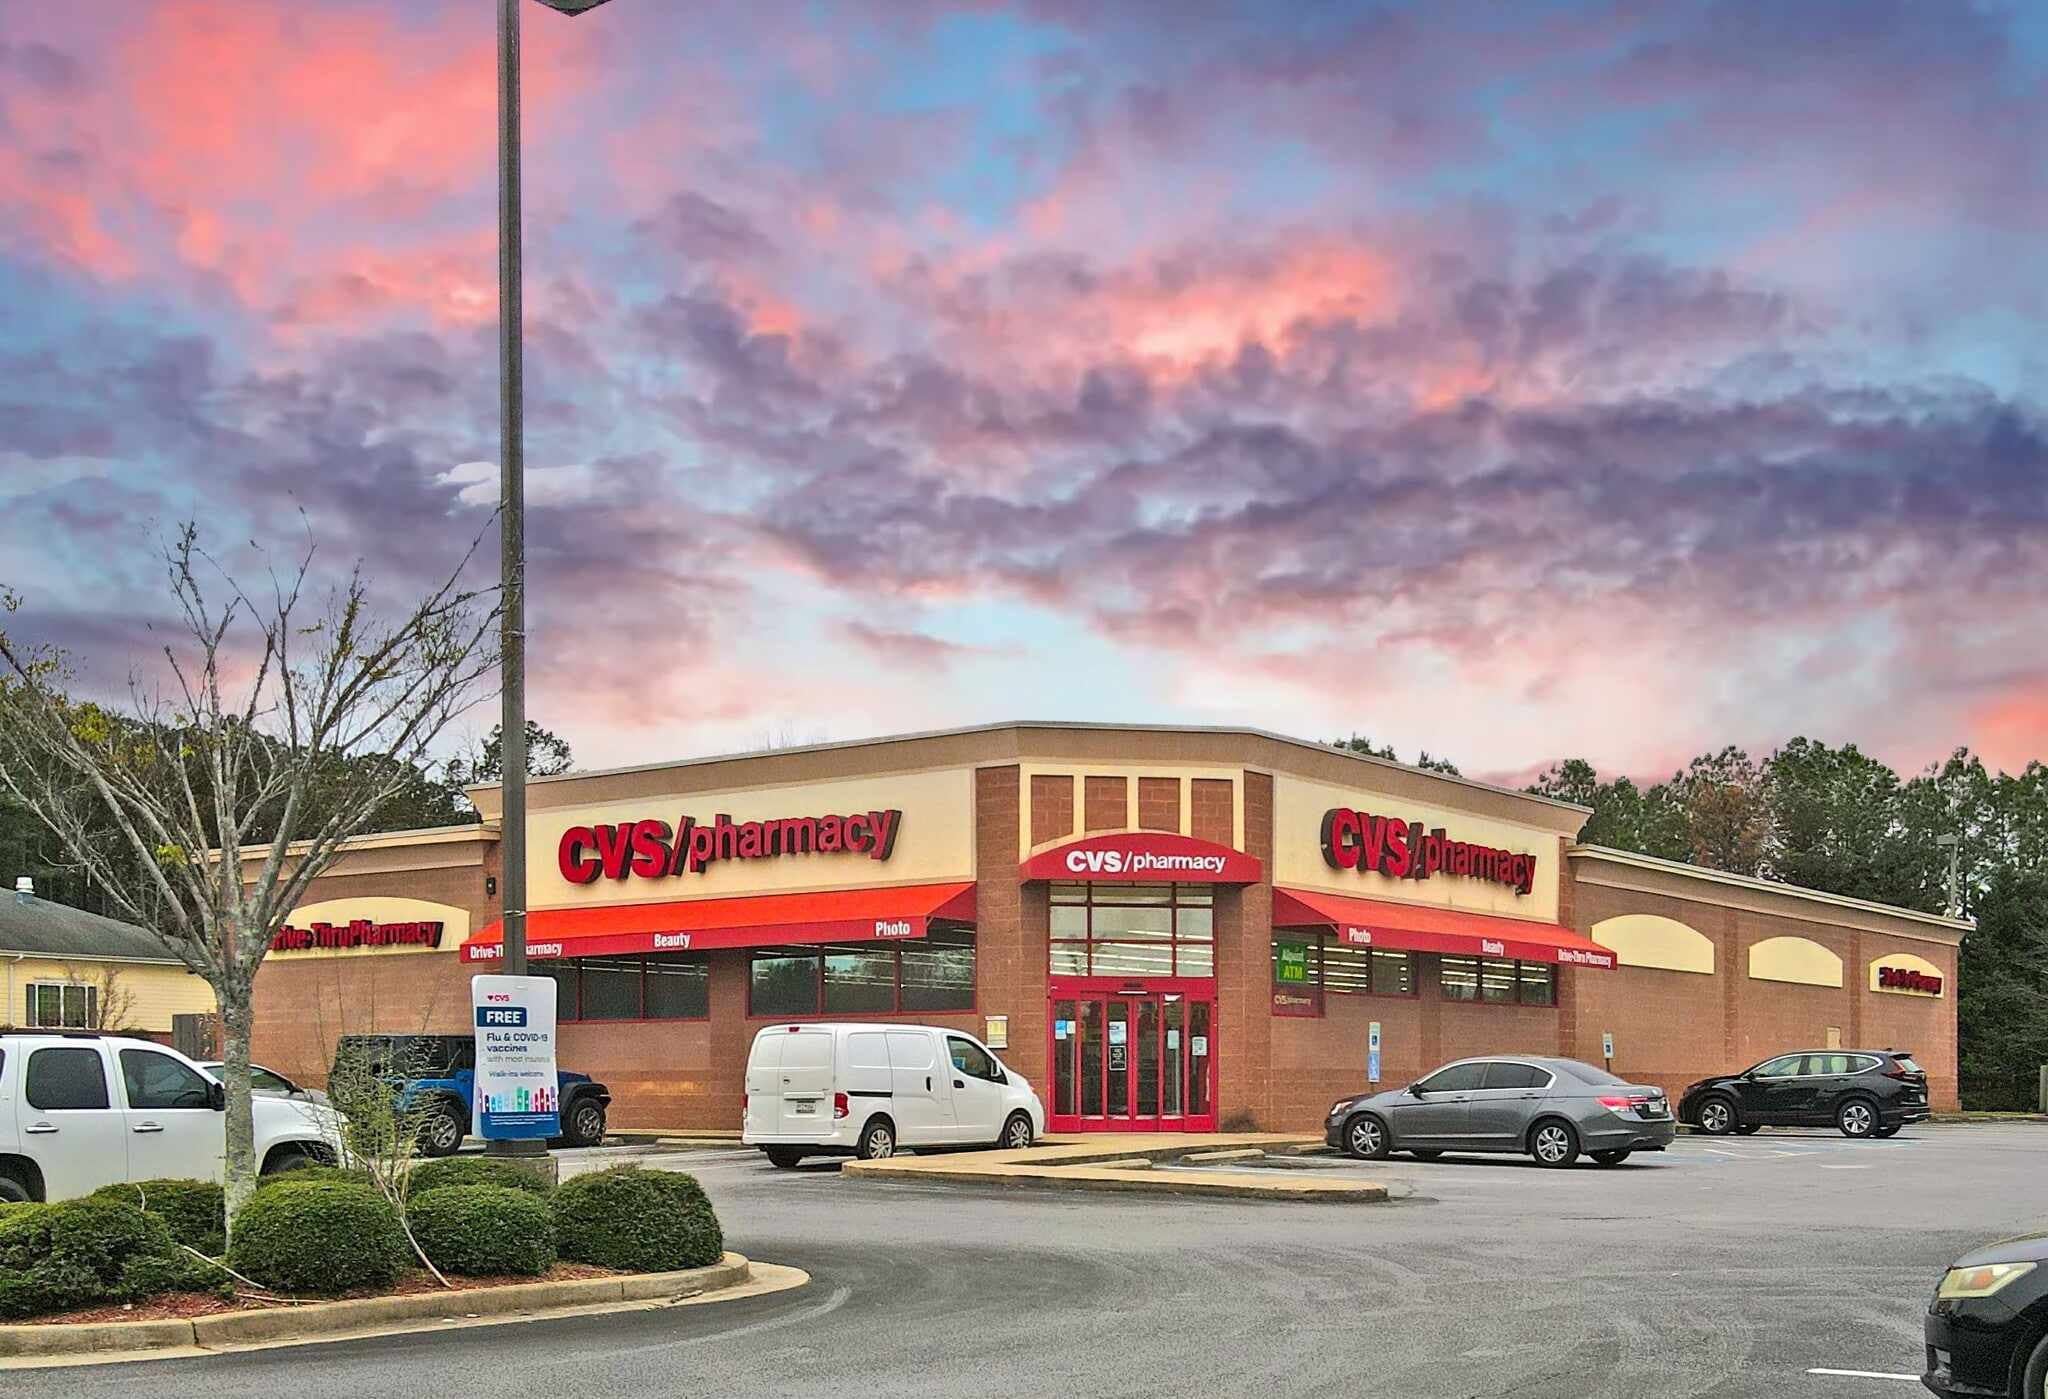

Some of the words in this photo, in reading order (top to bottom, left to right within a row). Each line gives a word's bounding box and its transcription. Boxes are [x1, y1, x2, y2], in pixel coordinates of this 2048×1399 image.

[558, 809, 901, 884] CVS/pharmacy
[1321, 807, 1536, 895] CVS/pharmacy
[1066, 850, 1226, 873] CVS/pharmacy
[350, 919, 444, 949] Pharmacy
[875, 920, 911, 937] Photo
[1348, 927, 1372, 943] Photo
[654, 932, 691, 949] Beauty
[470, 943, 504, 959] Drive-T
[526, 943, 563, 957] armacy
[1283, 965, 1303, 979] ATM
[494, 994, 510, 1002] CVS
[486, 1032, 502, 1042] Flu
[503, 1032, 511, 1042] &
[513, 1032, 548, 1042] COVID-19
[486, 1043, 528, 1053] vaccines
